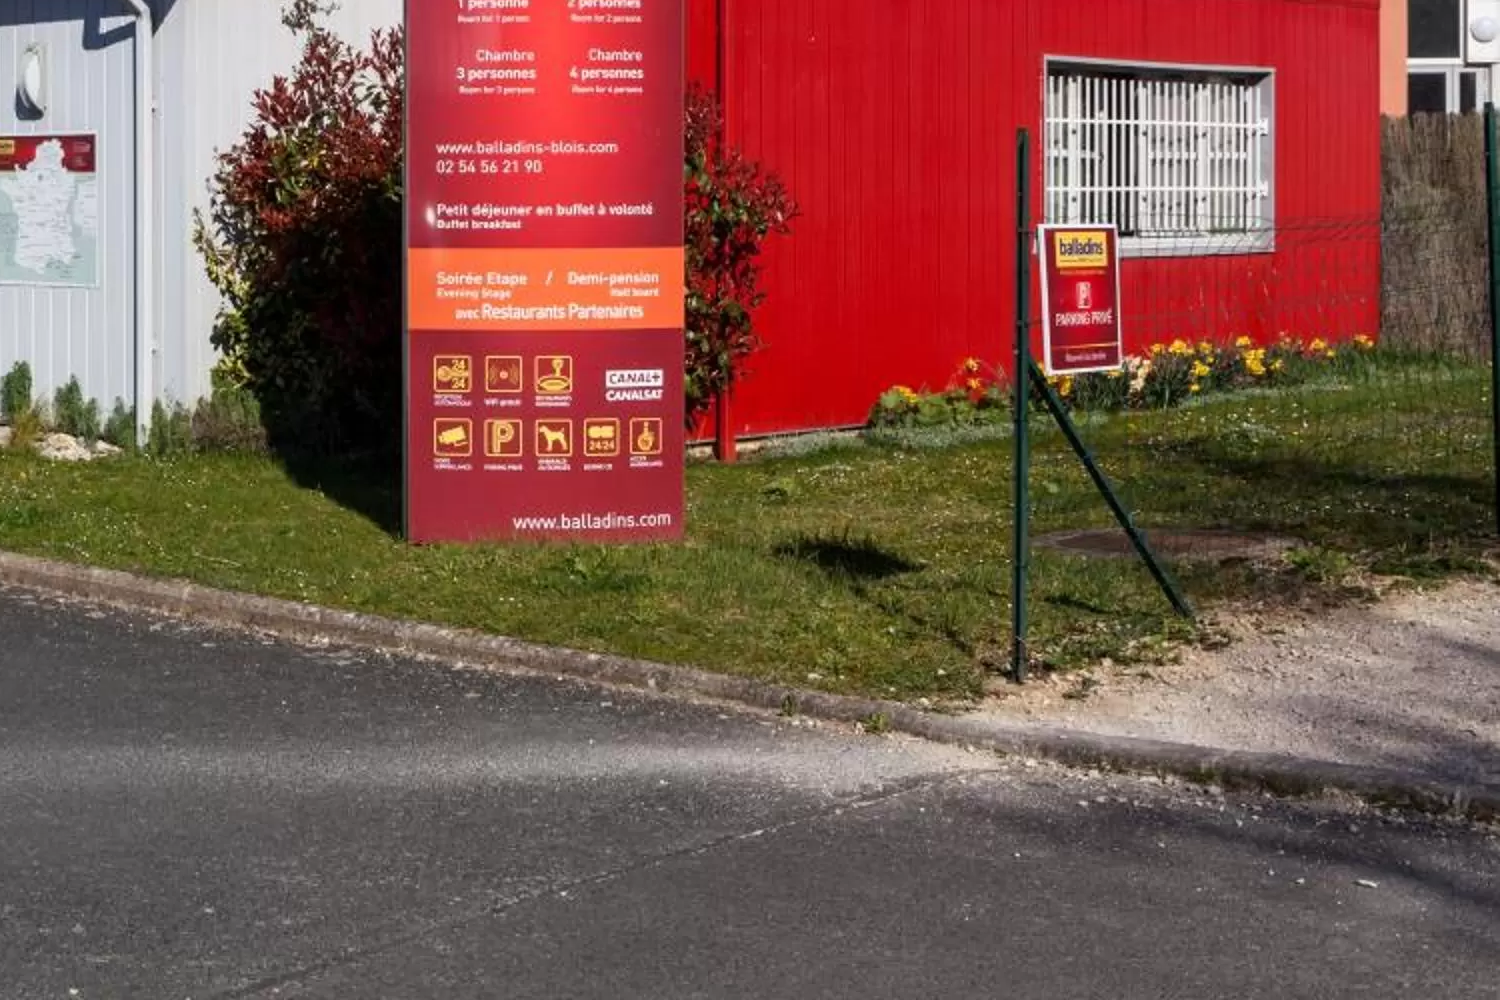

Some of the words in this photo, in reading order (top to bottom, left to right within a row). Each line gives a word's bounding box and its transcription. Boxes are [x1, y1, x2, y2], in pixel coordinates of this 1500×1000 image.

[475, 48, 535, 62] Chambre
[588, 48, 643, 62] Chambre
[456, 67, 465, 79] 3
[467, 68, 536, 82] personnes
[569, 65, 578, 79] 4
[581, 68, 644, 82] personnes
[436, 140, 619, 154] www.balladins-blois.com
[436, 160, 454, 174] 02
[459, 160, 475, 174] 54
[480, 160, 498, 174] 56
[503, 160, 518, 174] 21
[524, 160, 543, 174] 90
[436, 203, 468, 216] Petit
[472, 203, 532, 219] déjeuner
[536, 206, 553, 216] en
[557, 203, 595, 216] buffet
[609, 202, 653, 215] volonté
[1059, 238, 1103, 255] balladins
[436, 270, 483, 285] Soirée
[568, 271, 660, 288] Demi-pension
[456, 309, 480, 319] avec
[482, 303, 565, 320] Restaurants
[568, 302, 644, 319] Partenaires
[1055, 312, 1091, 327] PARKING
[609, 372, 661, 385] CANAL+
[606, 388, 664, 401] CANALSAT
[513, 513, 671, 530] www.balladins.com
